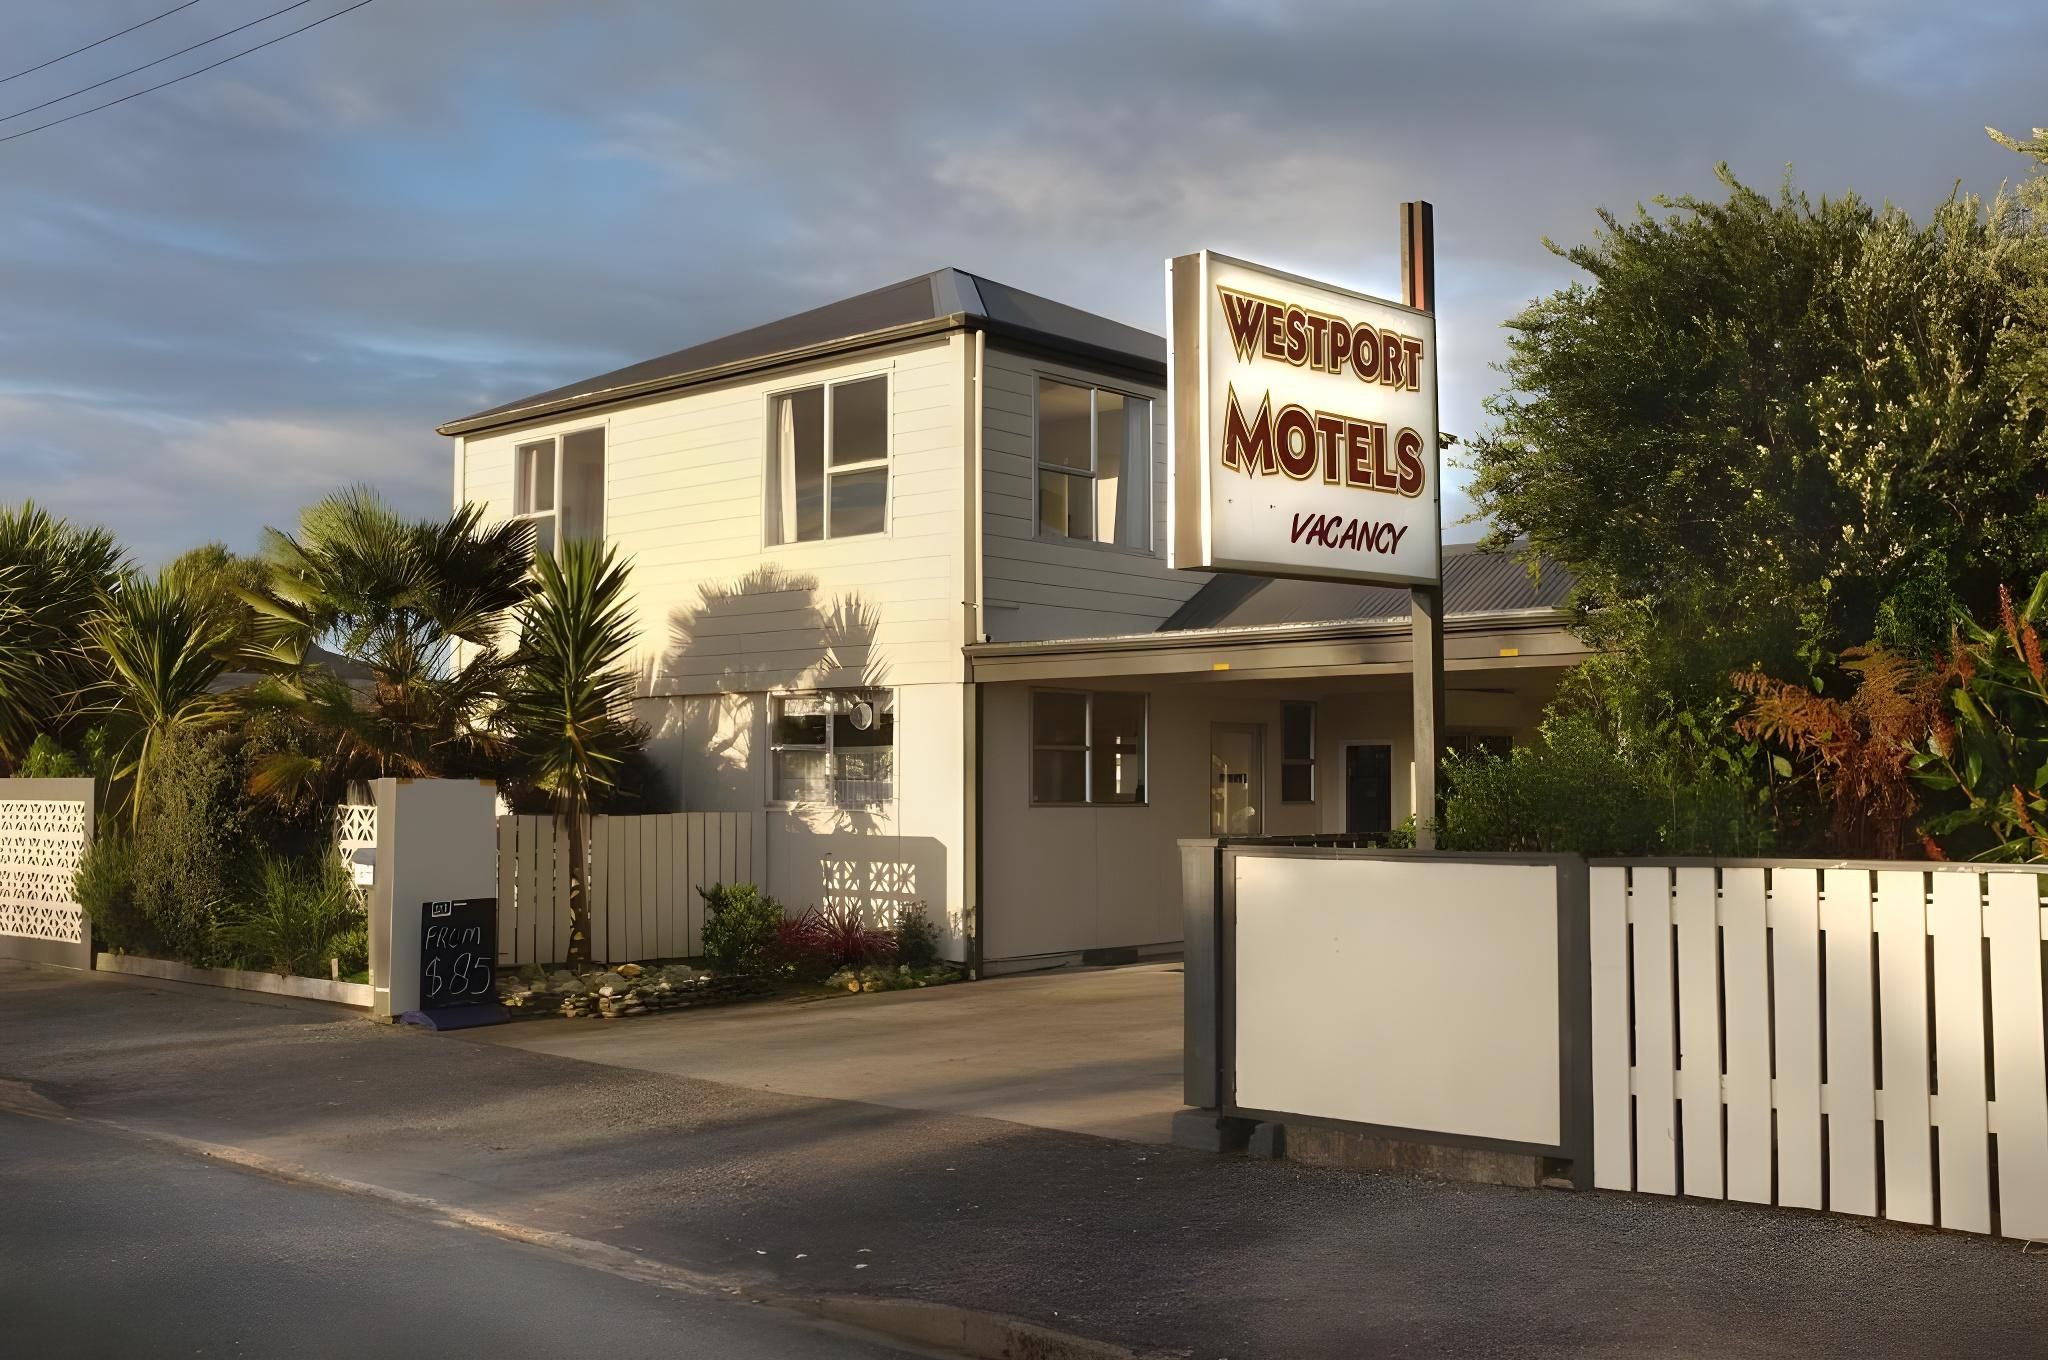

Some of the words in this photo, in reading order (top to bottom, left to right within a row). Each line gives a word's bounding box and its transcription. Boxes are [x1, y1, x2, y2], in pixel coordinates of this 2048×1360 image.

[1217, 285, 1423, 391] WESTPORT
[1222, 381, 1425, 497] MOTELS
[1290, 513, 1407, 554] VACANCY
